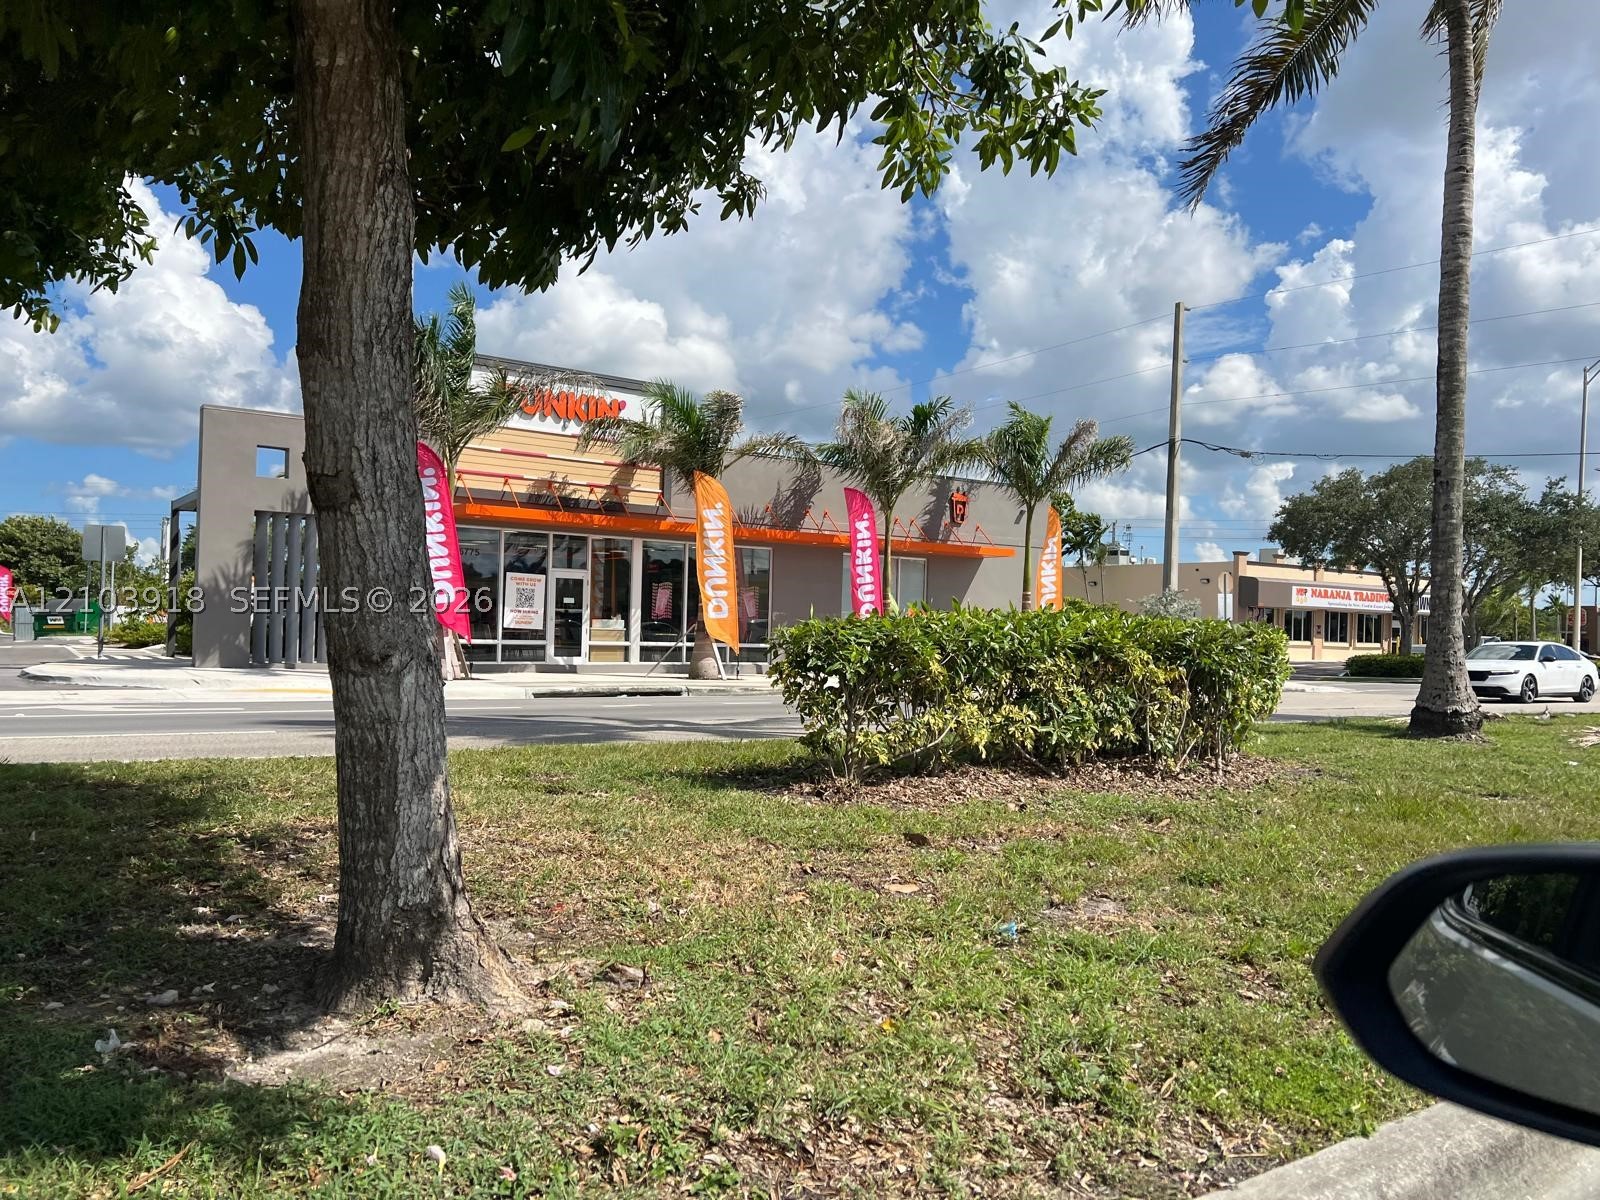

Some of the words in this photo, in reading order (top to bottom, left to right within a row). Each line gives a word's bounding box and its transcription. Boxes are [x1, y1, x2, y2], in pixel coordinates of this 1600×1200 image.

[507, 385, 627, 422] UNKIN'
[956, 504, 964, 515] D
[1310, 588, 1351, 601] NARANJA
[1353, 591, 1391, 603] TRADING
